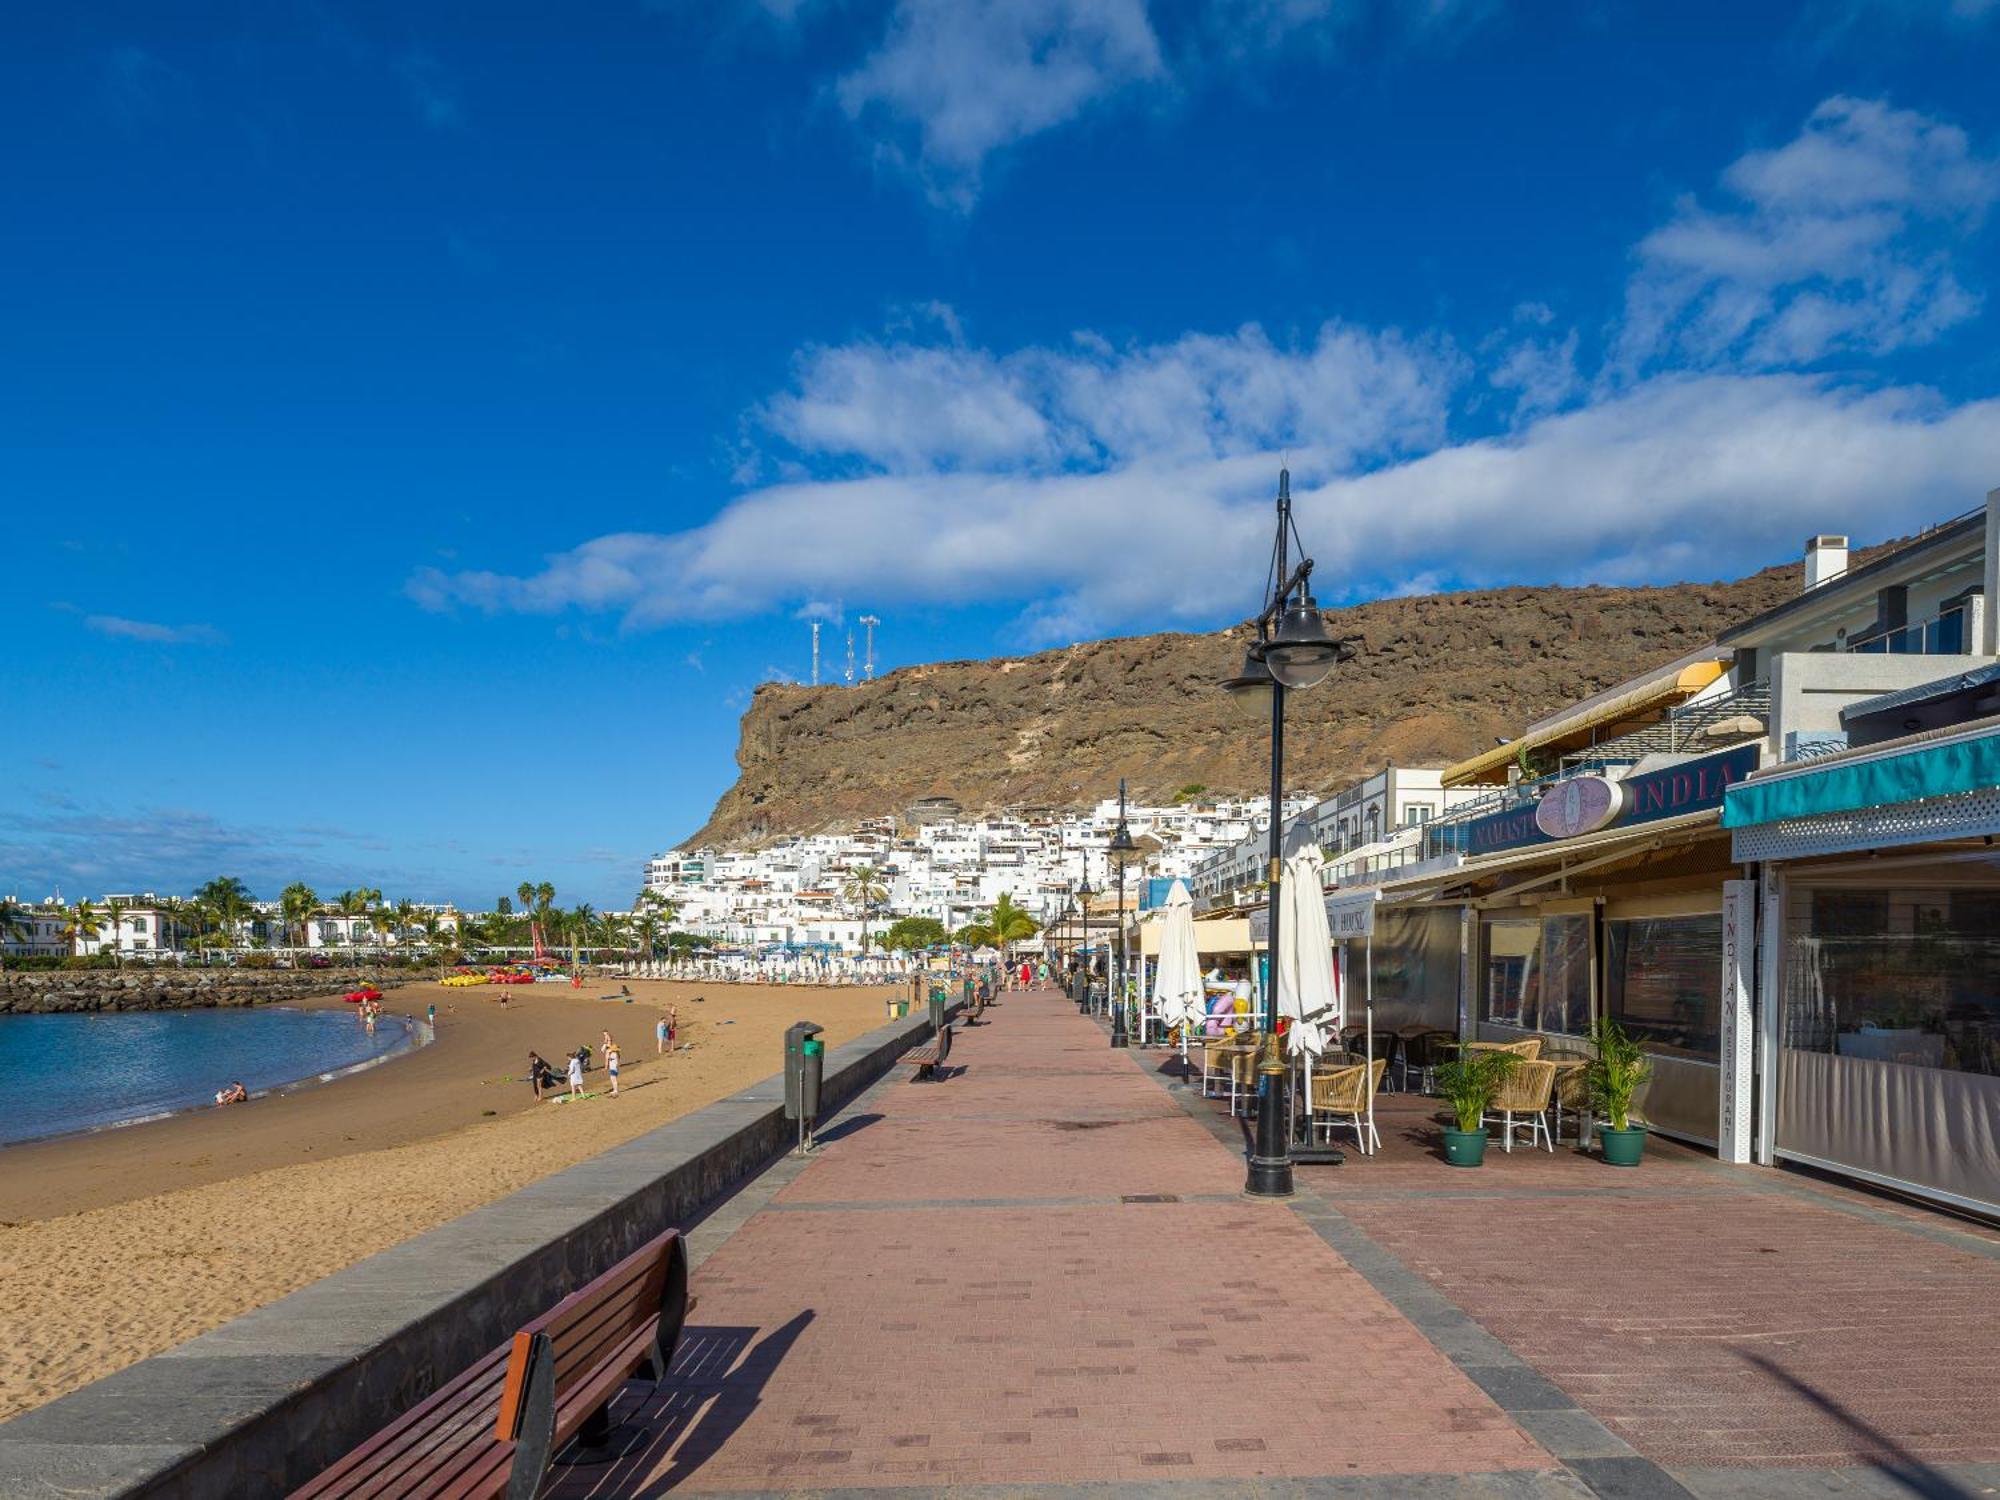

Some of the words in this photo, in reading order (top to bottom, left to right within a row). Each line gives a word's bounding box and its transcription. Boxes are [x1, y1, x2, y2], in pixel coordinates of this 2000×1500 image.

[1632, 761, 1735, 816] INDIA
[1341, 911, 1365, 932] HOUSE
[1725, 895, 1738, 1017] INDIAN
[1724, 1026, 1733, 1137] RESTAURANT
